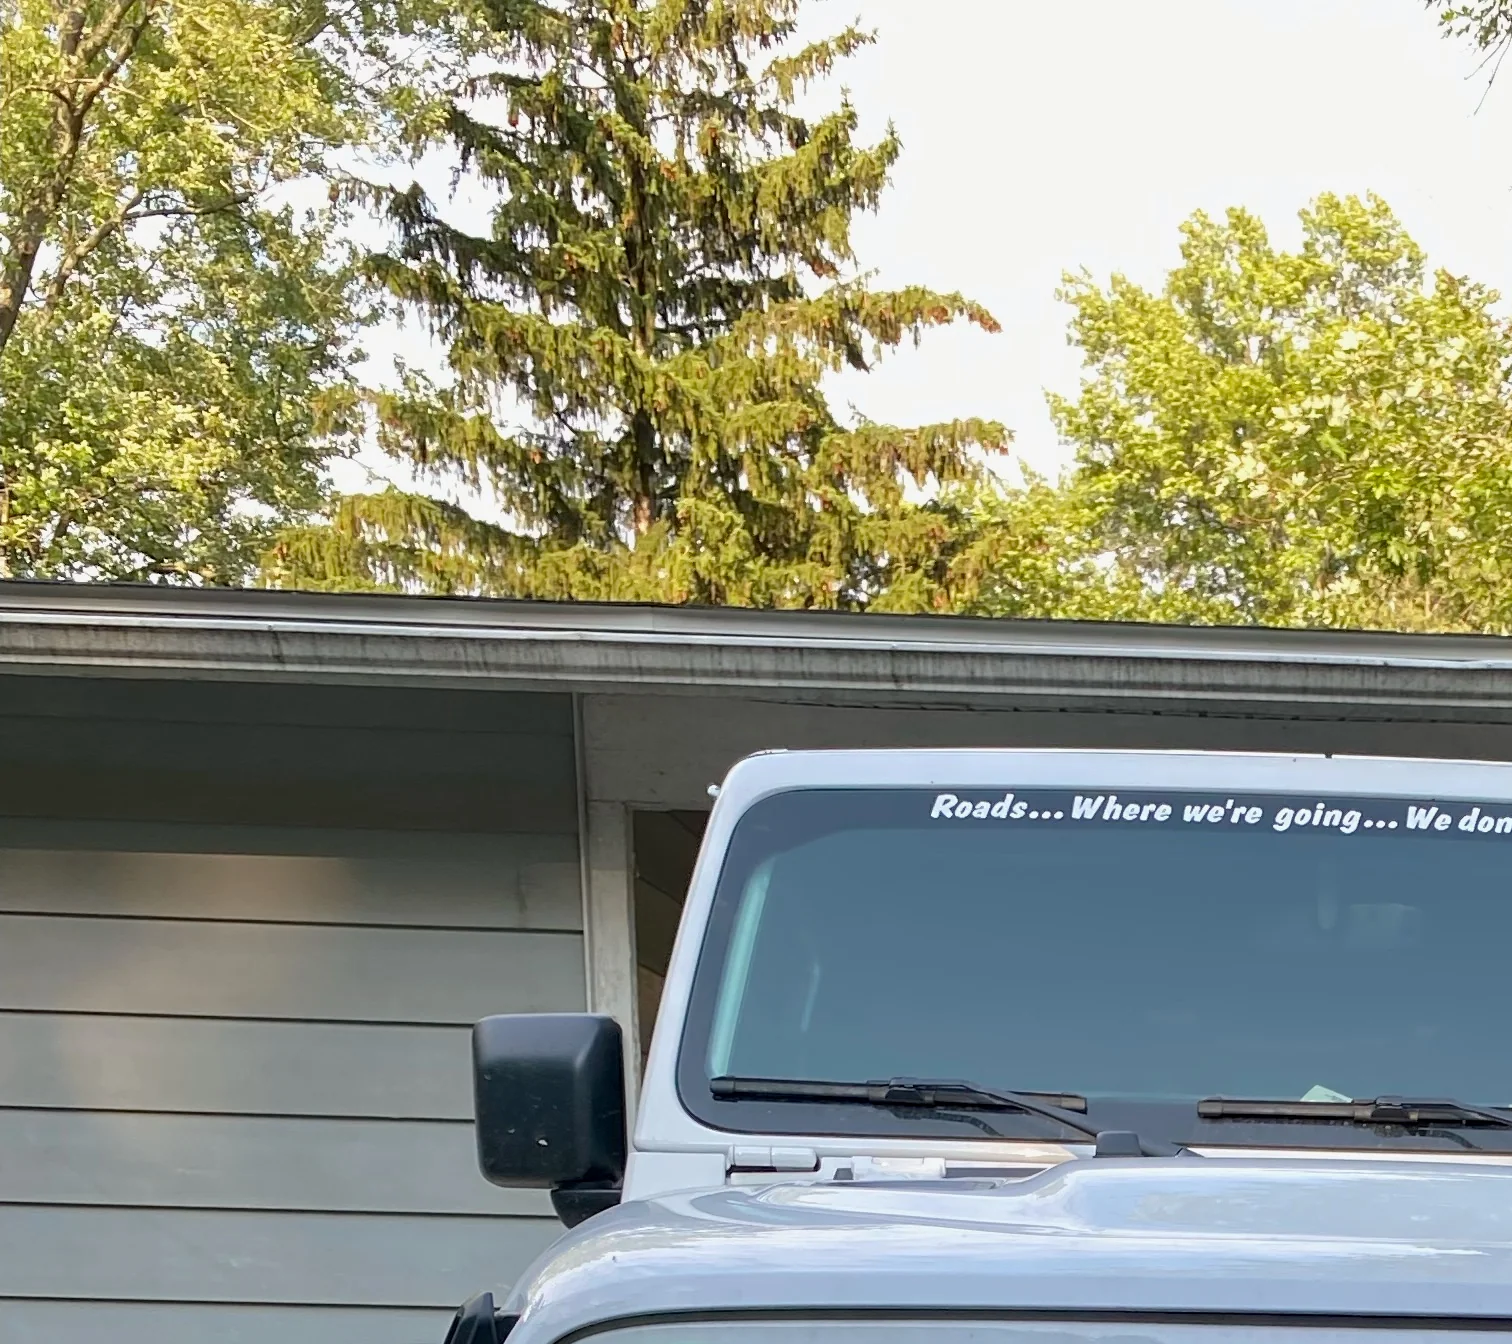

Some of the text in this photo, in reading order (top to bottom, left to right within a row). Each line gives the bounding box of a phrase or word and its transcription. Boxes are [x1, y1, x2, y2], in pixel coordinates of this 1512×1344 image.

[930, 793, 1064, 820] Roads...
[1071, 795, 1172, 822] Where
[1183, 798, 1263, 824] we're
[1272, 802, 1398, 834] going...
[1406, 805, 1452, 831] We
